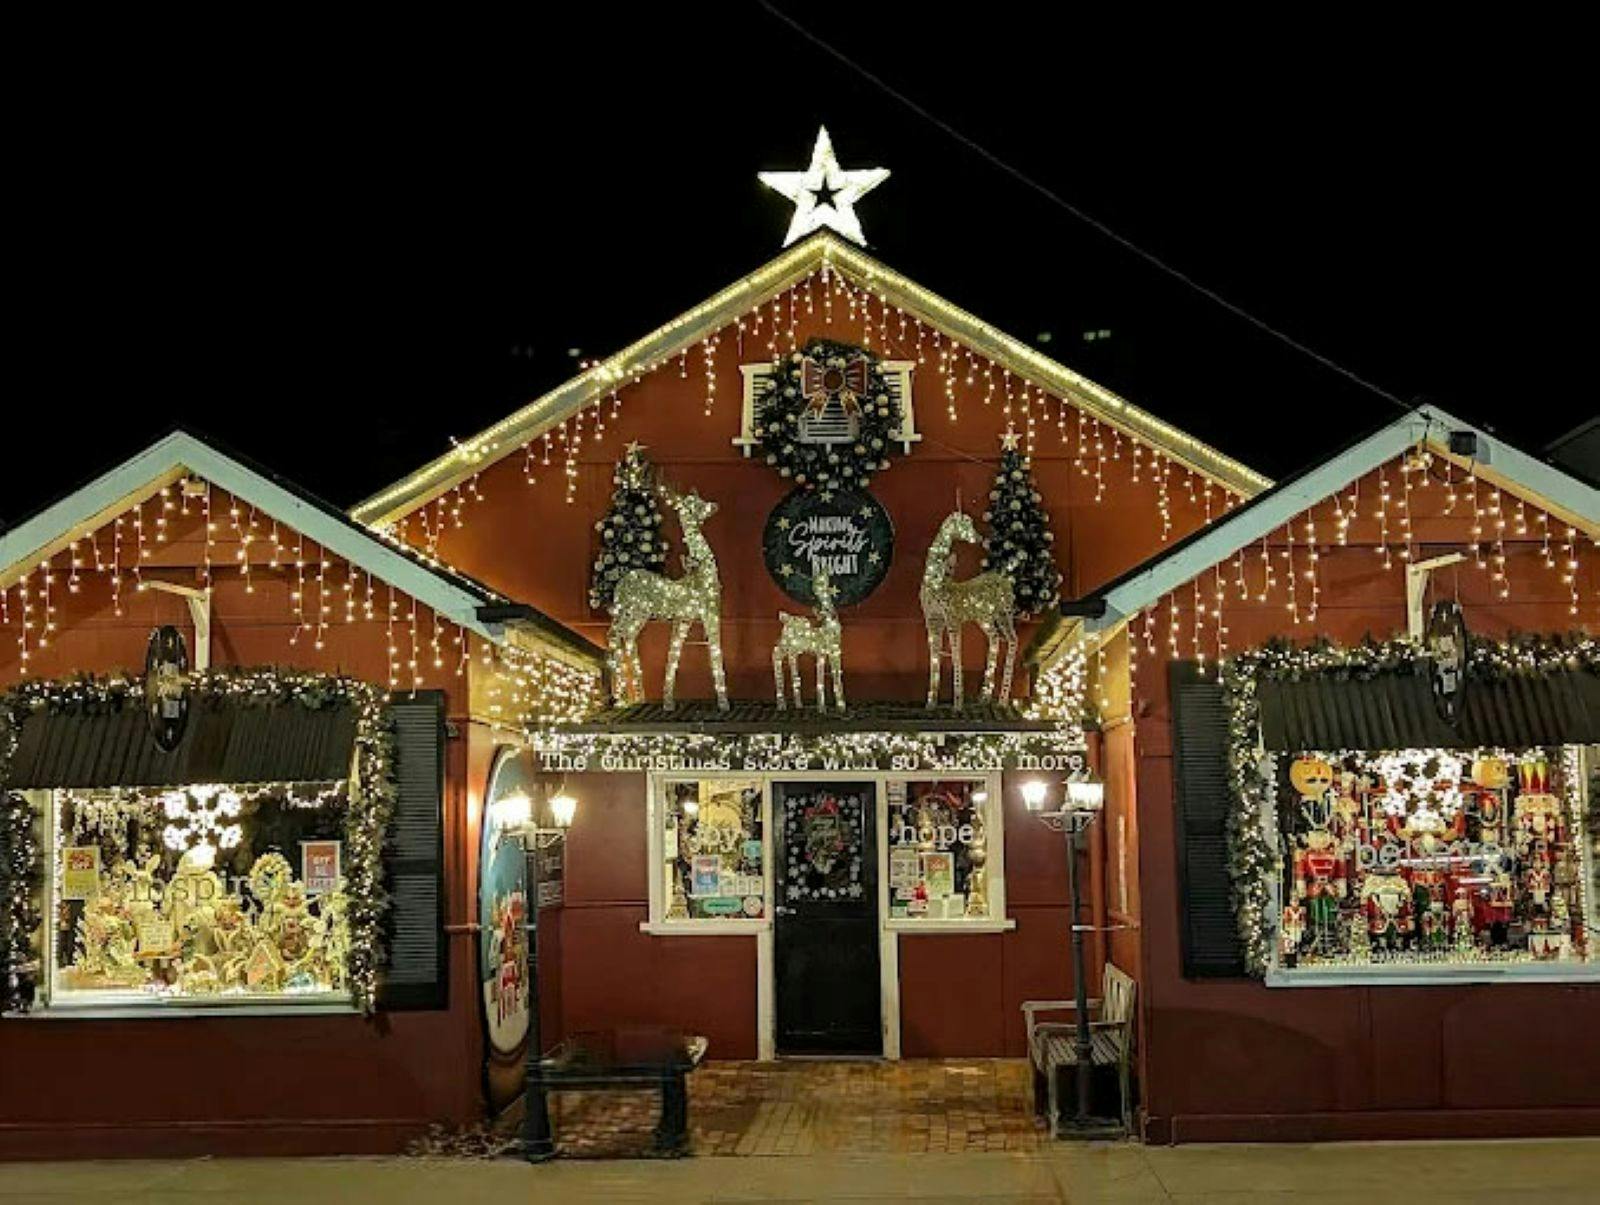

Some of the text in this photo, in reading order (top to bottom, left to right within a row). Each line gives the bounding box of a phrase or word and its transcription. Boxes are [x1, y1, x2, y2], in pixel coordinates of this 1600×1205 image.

[788, 521, 869, 561] Spirits
[812, 554, 858, 575] BRIGHT
[540, 751, 587, 771] The
[891, 754, 920, 771] so
[1016, 754, 1083, 771] more
[897, 821, 975, 850] hope
